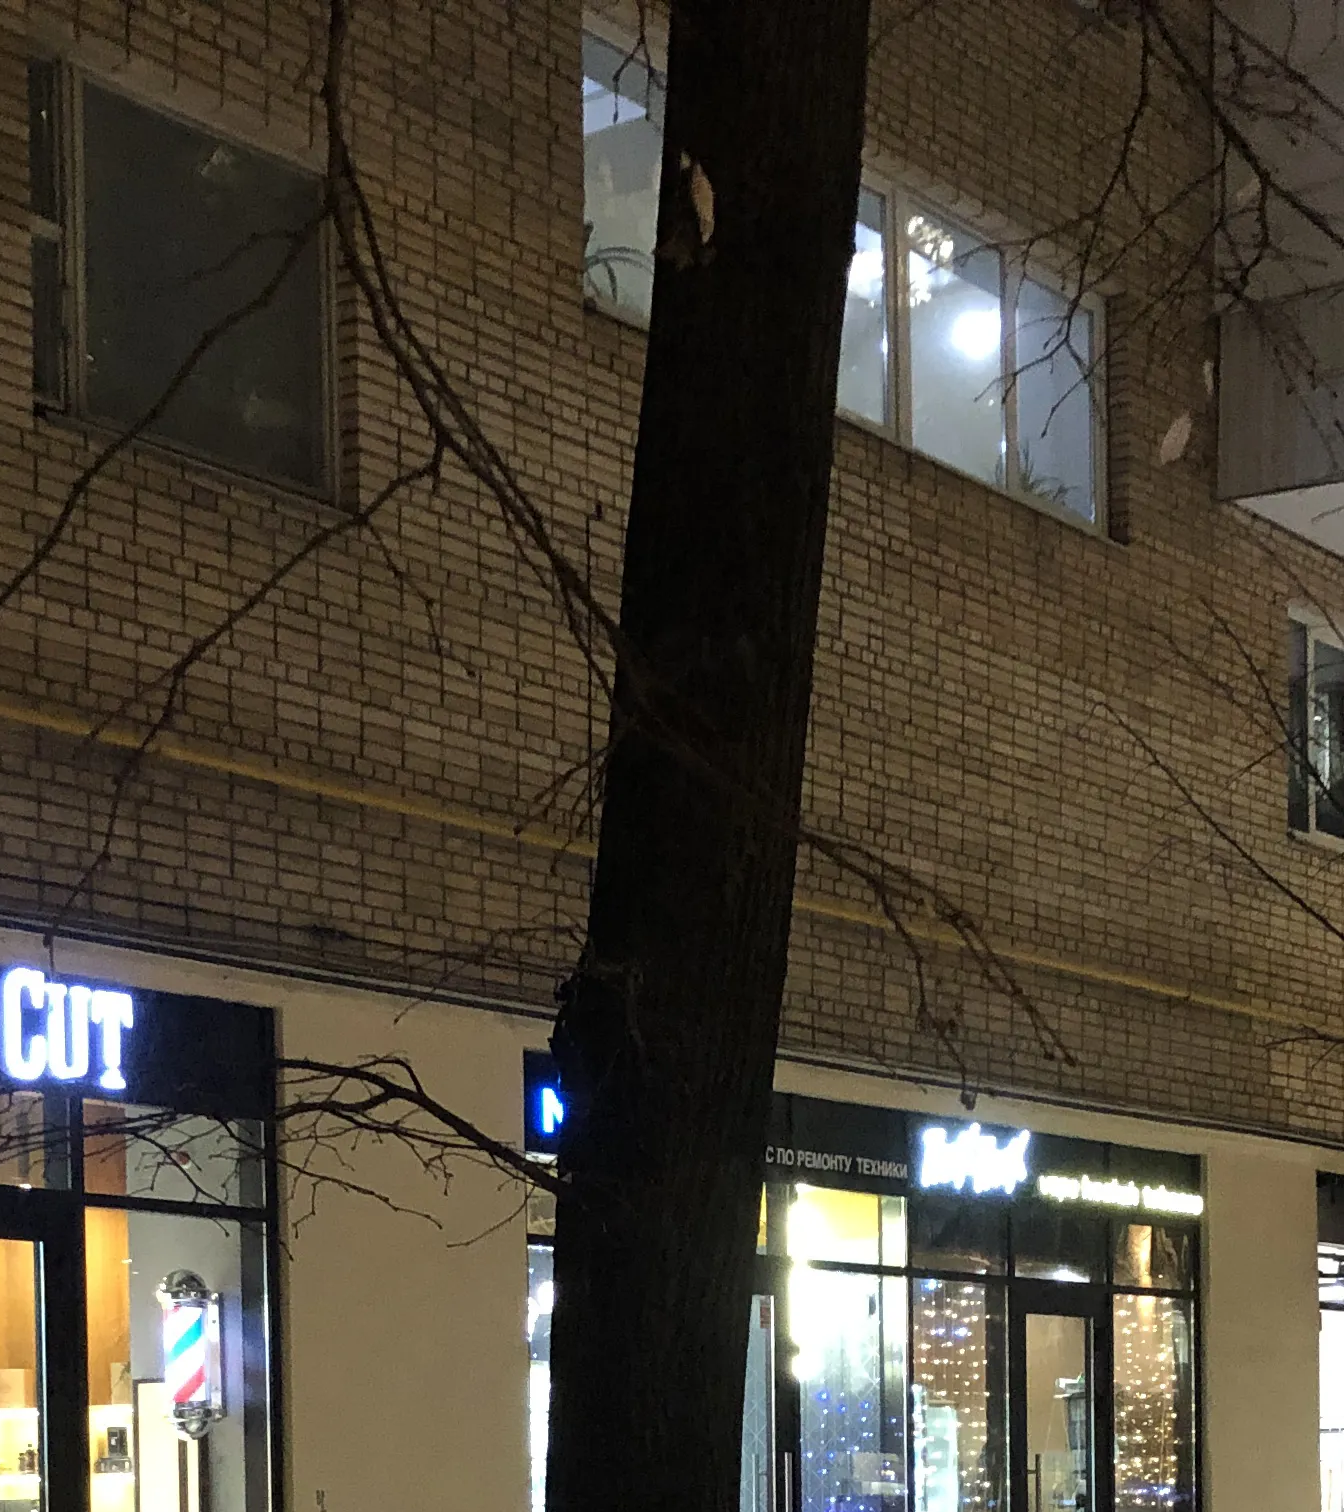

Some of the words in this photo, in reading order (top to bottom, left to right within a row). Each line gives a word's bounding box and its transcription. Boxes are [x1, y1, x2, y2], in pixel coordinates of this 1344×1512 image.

[3, 966, 134, 1090] CUT
[777, 1147, 795, 1166] ПО
[796, 1150, 852, 1173] РЕМОНТУ
[856, 1156, 909, 1179] ТЕХНИКИ
